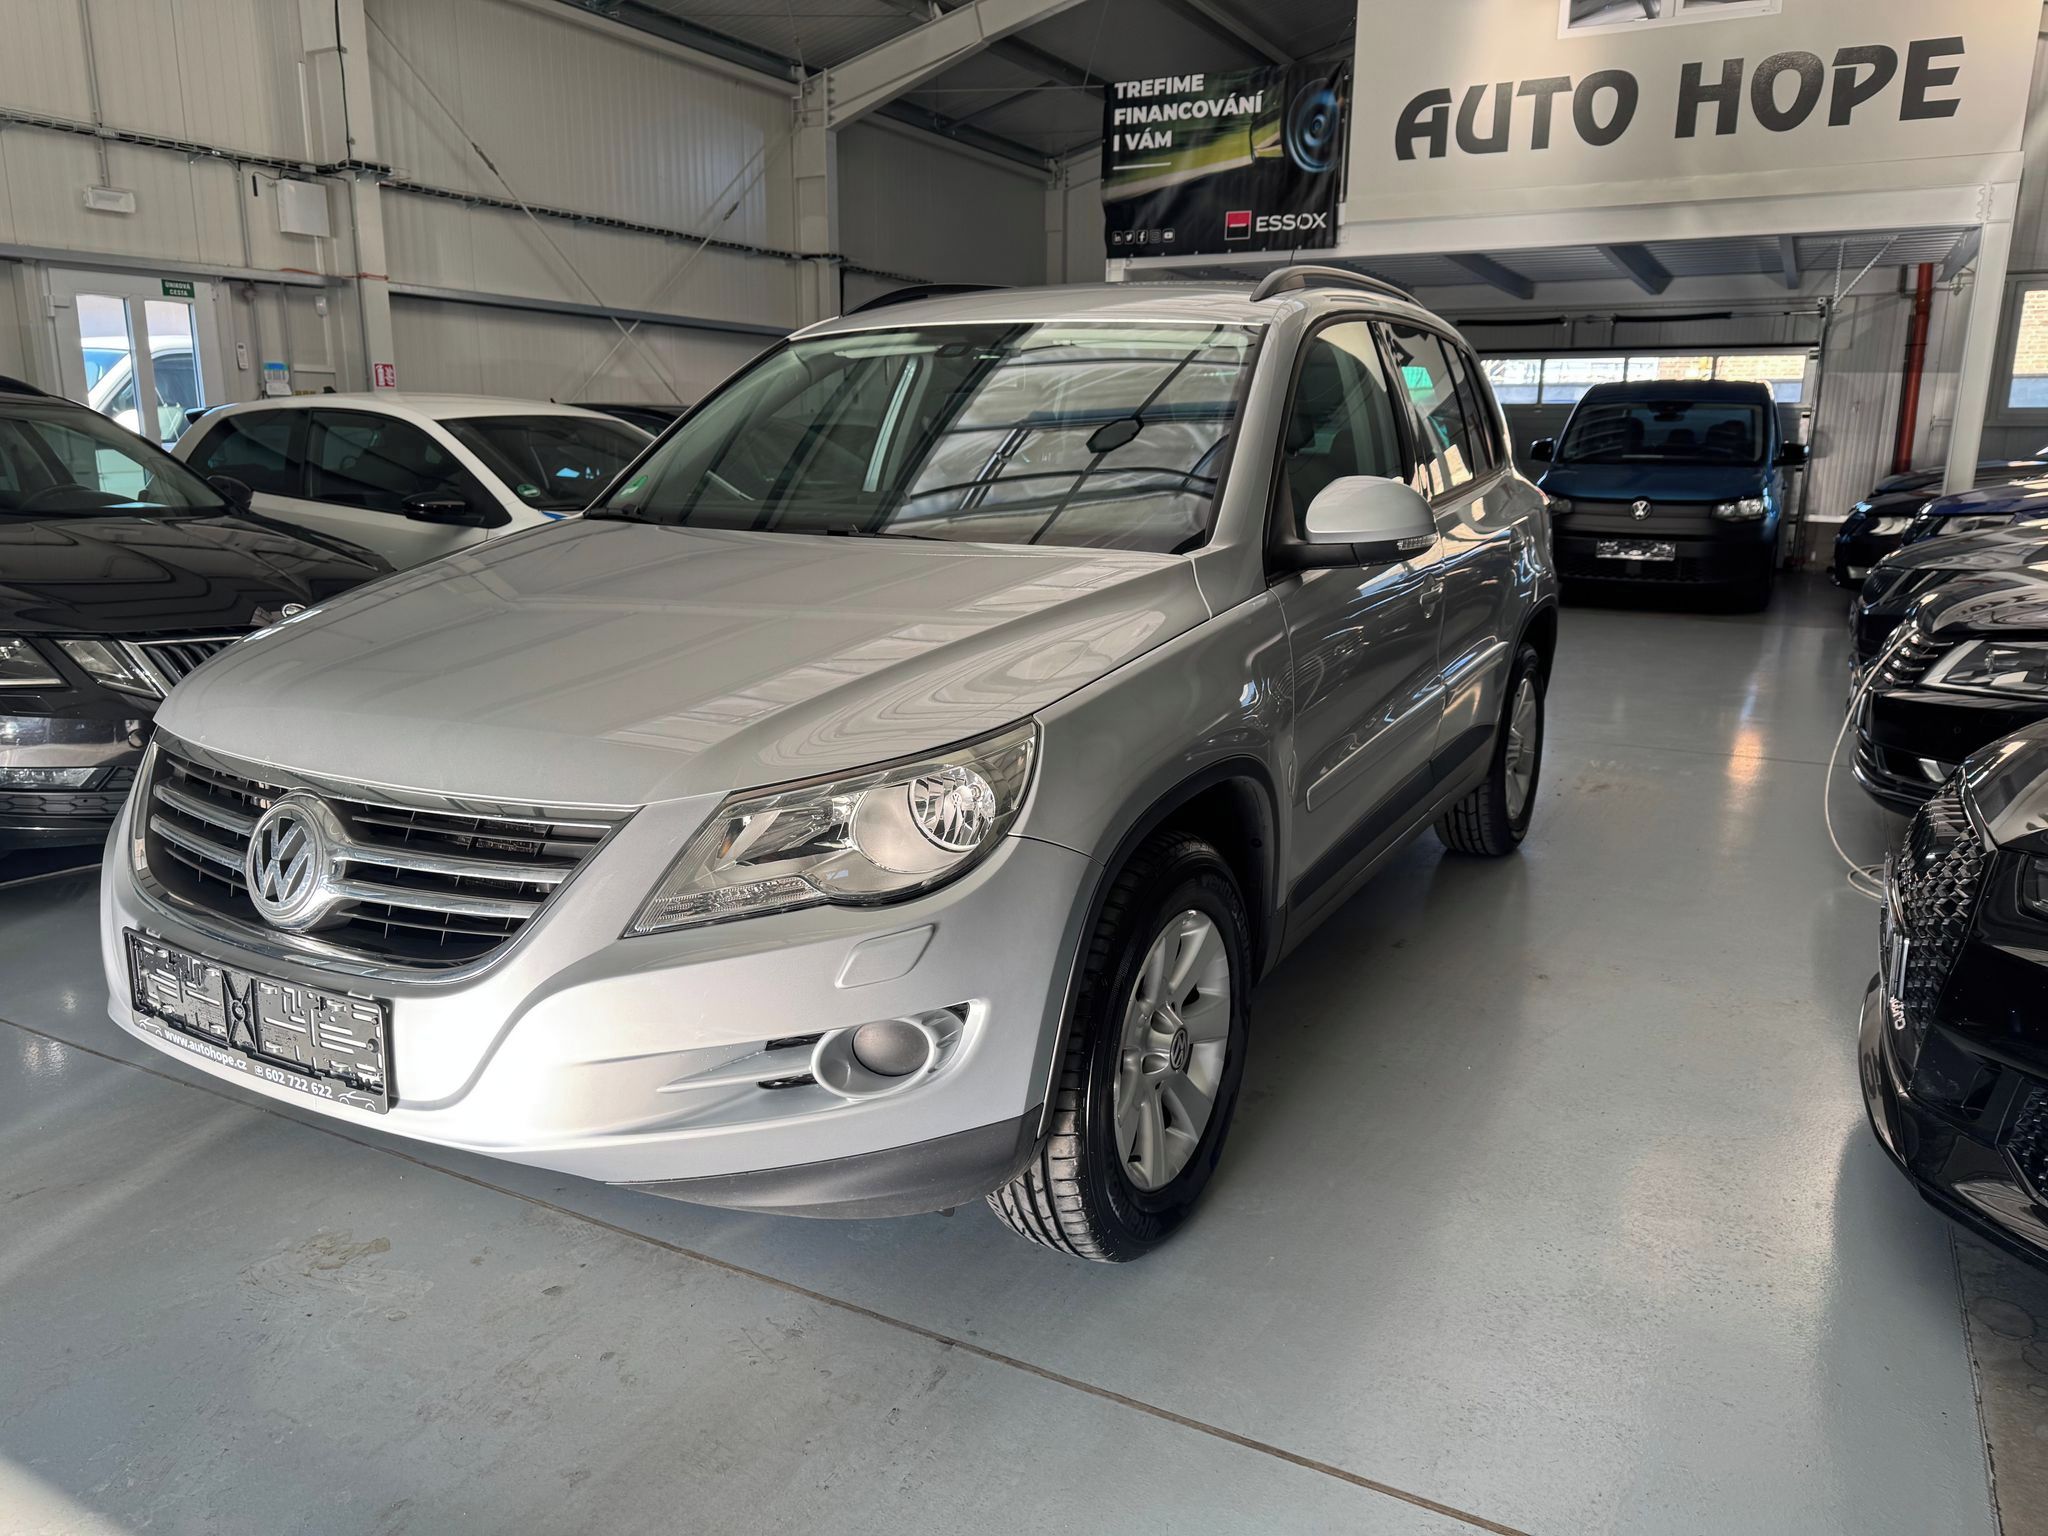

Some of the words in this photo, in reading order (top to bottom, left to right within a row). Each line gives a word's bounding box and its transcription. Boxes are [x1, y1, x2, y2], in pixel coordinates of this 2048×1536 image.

[1114, 74, 1205, 99] TREFIME
[1395, 69, 1639, 160] AUTO
[1674, 36, 1965, 138] HOPE
[1114, 90, 1264, 126] FINANCOVÁNÍ
[1113, 134, 1120, 152] I
[1125, 127, 1172, 150] VÁM
[1256, 212, 1327, 232] ESSOX
[164, 1029, 247, 1070] www.autohope.cz
[265, 1067, 286, 1085] 602
[288, 1074, 309, 1092] 722
[311, 1081, 333, 1099] 622
